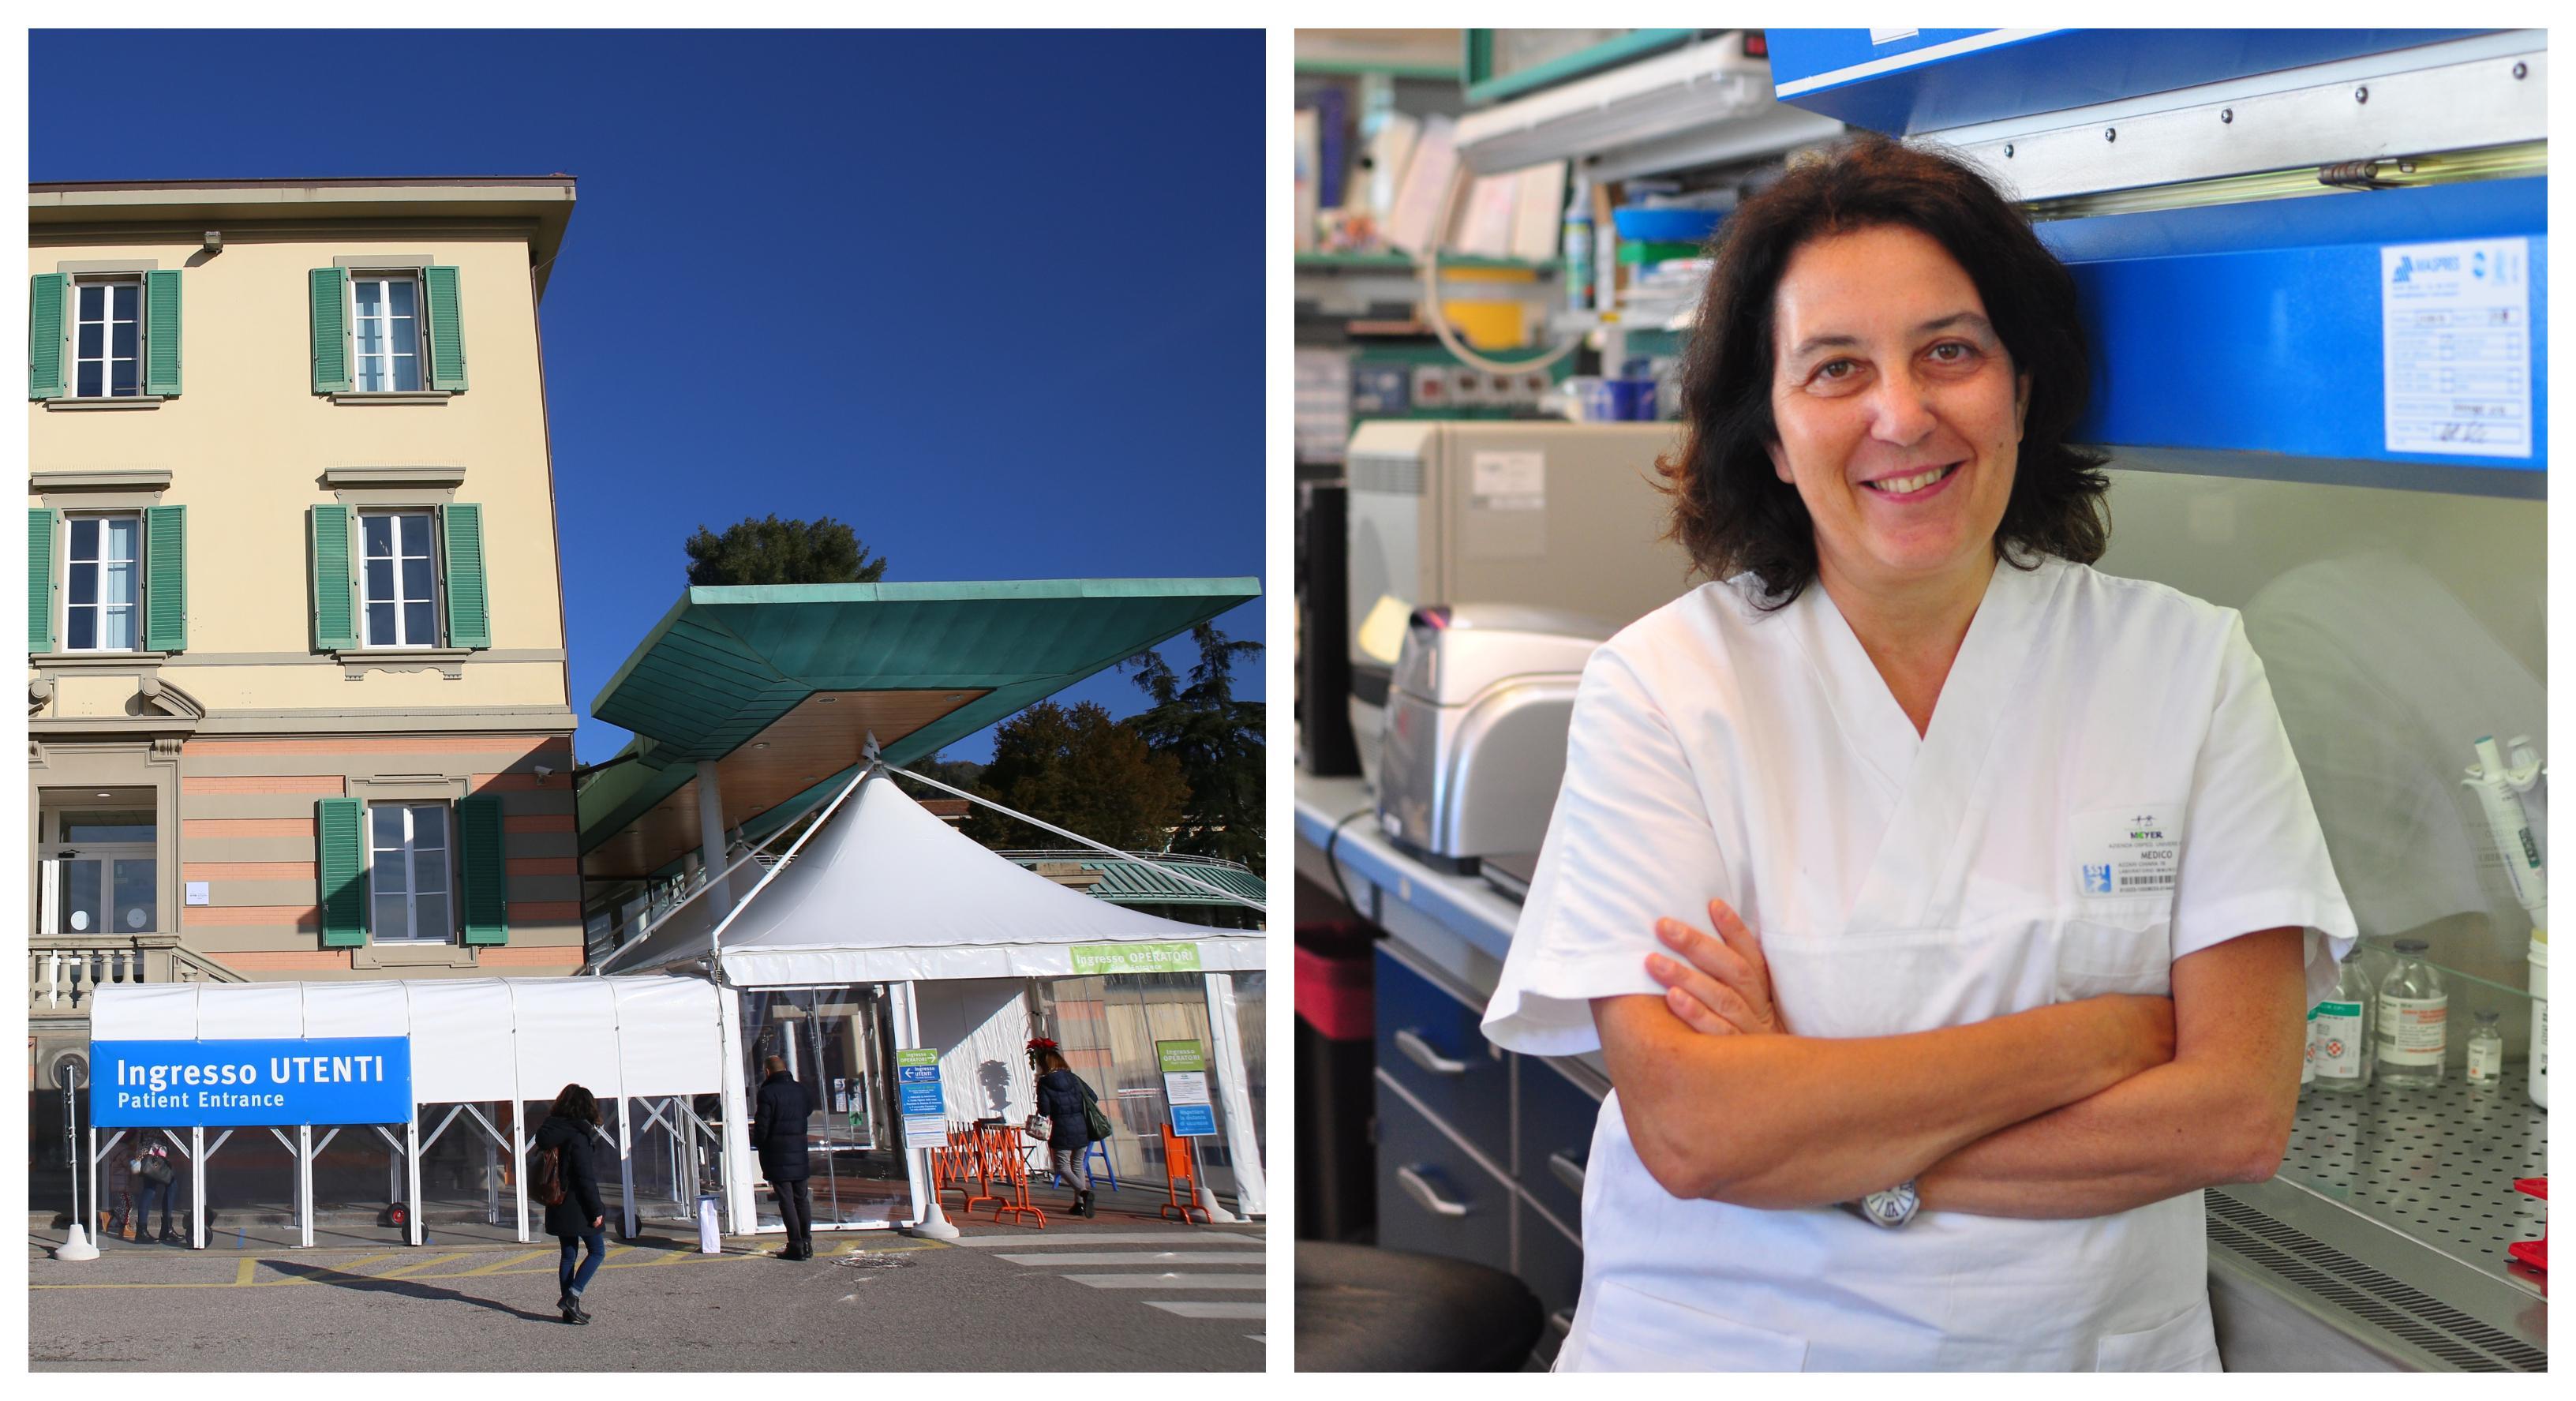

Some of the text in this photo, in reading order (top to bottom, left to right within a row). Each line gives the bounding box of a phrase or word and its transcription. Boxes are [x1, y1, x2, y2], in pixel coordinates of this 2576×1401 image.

[2141, 850, 2173, 859] MEDICO
[1076, 950, 1193, 966] Ingresso OPERATORI
[118, 1055, 384, 1092] Ingresso UTENTI
[118, 1091, 285, 1109] Patient Entrance
